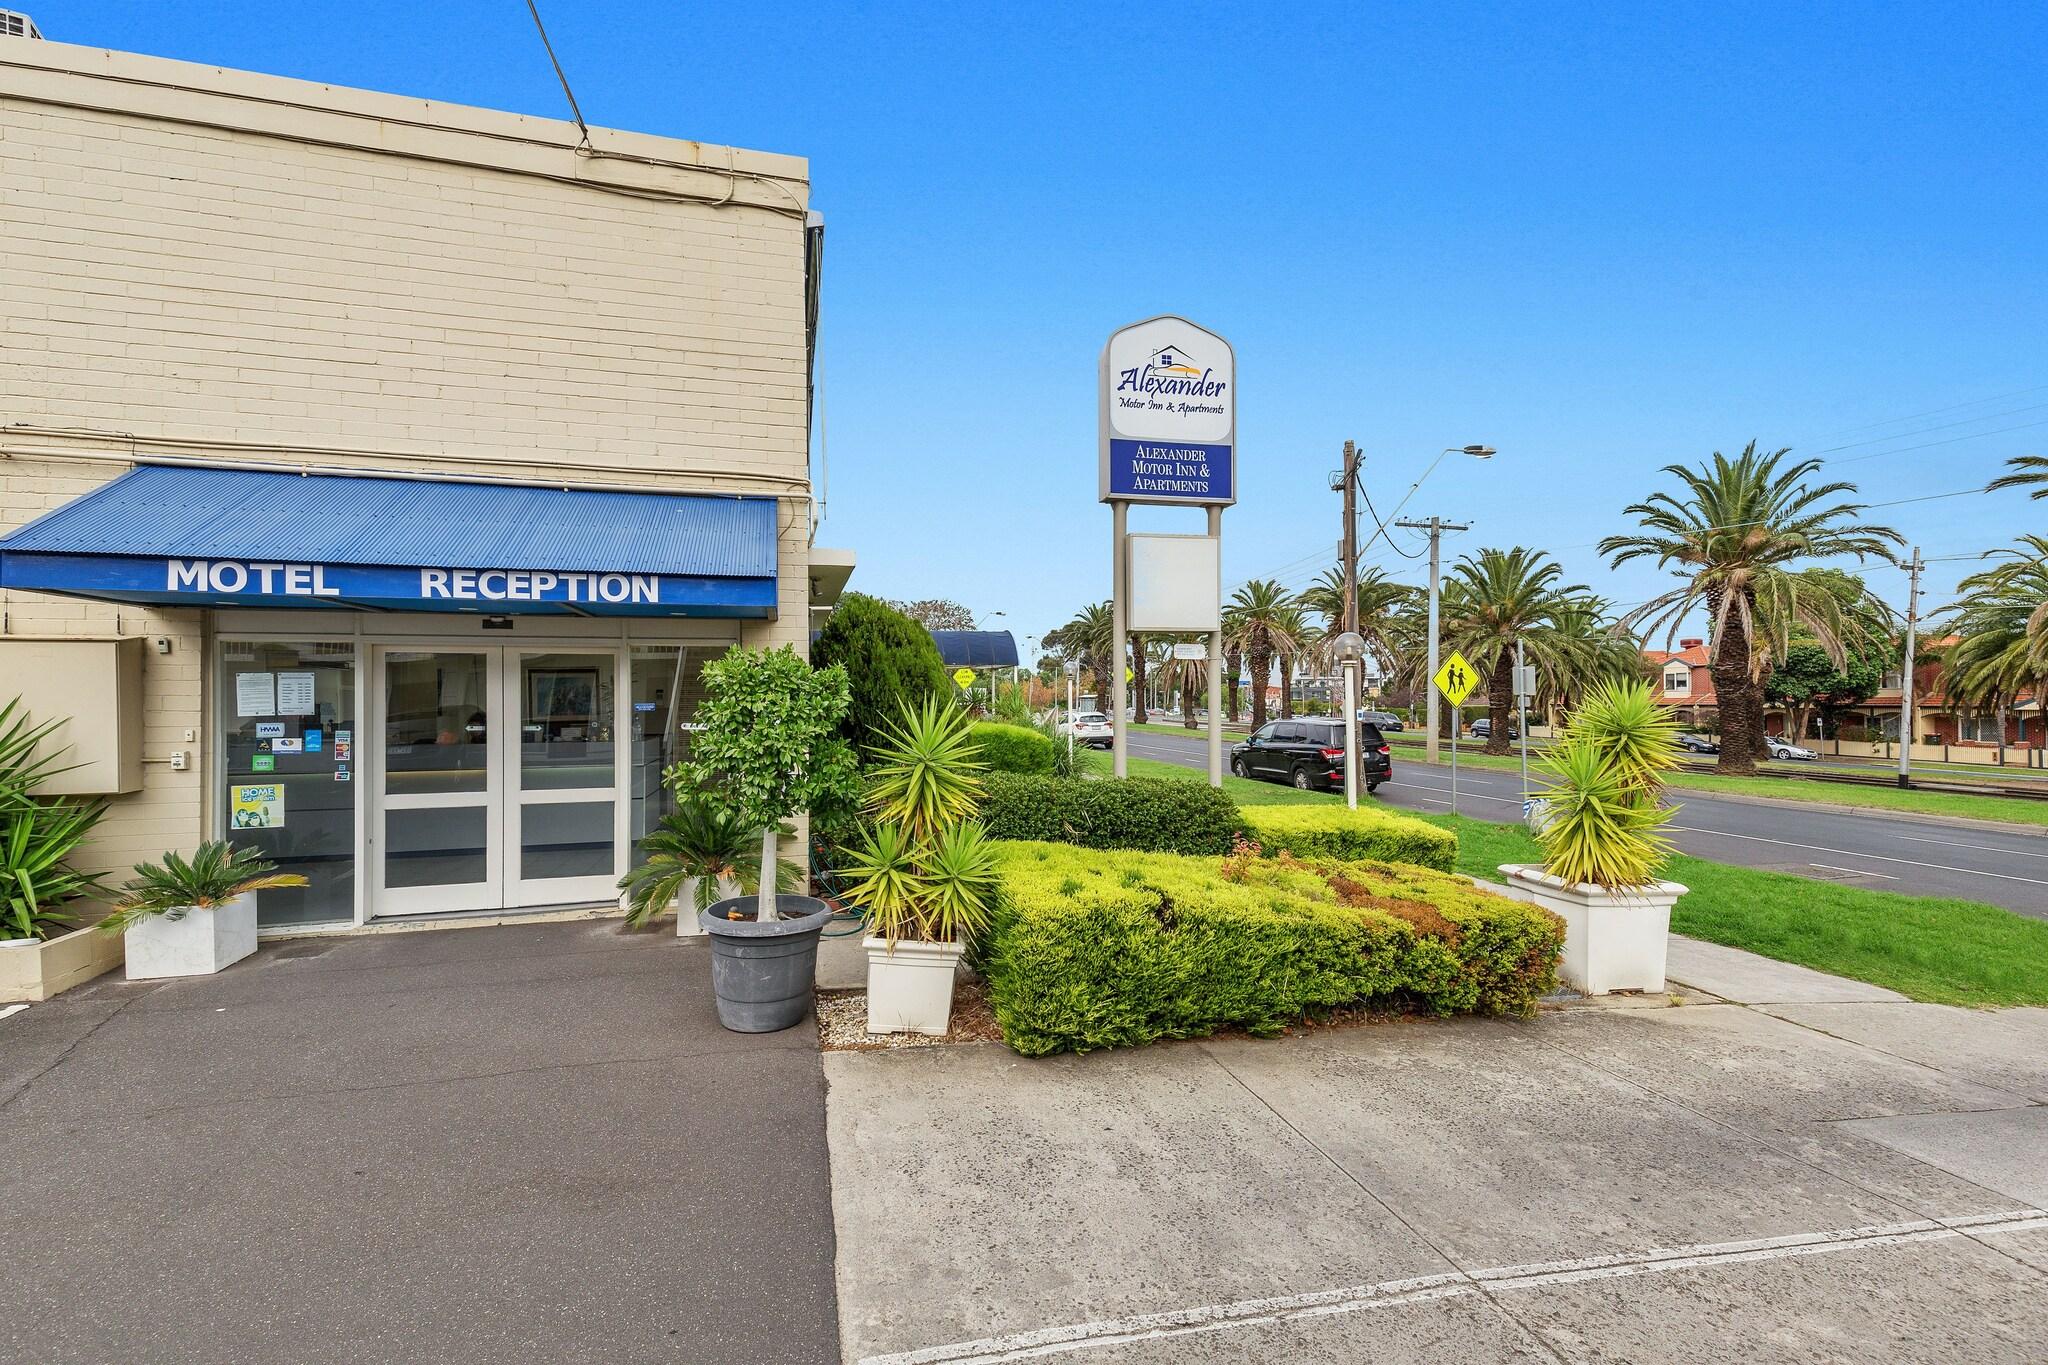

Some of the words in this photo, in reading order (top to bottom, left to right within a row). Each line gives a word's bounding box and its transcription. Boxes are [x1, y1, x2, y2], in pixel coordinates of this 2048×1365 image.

[1117, 364, 1226, 399] Alexander
[1119, 397, 1145, 409] Motor
[1148, 400, 1164, 410] Inn
[1166, 402, 1175, 413] &
[1178, 402, 1225, 417] Apartments
[1135, 444, 1207, 461] ALEXANDER
[1132, 460, 1173, 475] MOTOR
[1176, 462, 1197, 477] INN
[1200, 463, 1211, 477] &
[1133, 476, 1209, 492] APARTMENTS
[167, 560, 340, 596] MOTEL
[420, 568, 659, 603] RECEPTION
[241, 787, 274, 798] HOME
